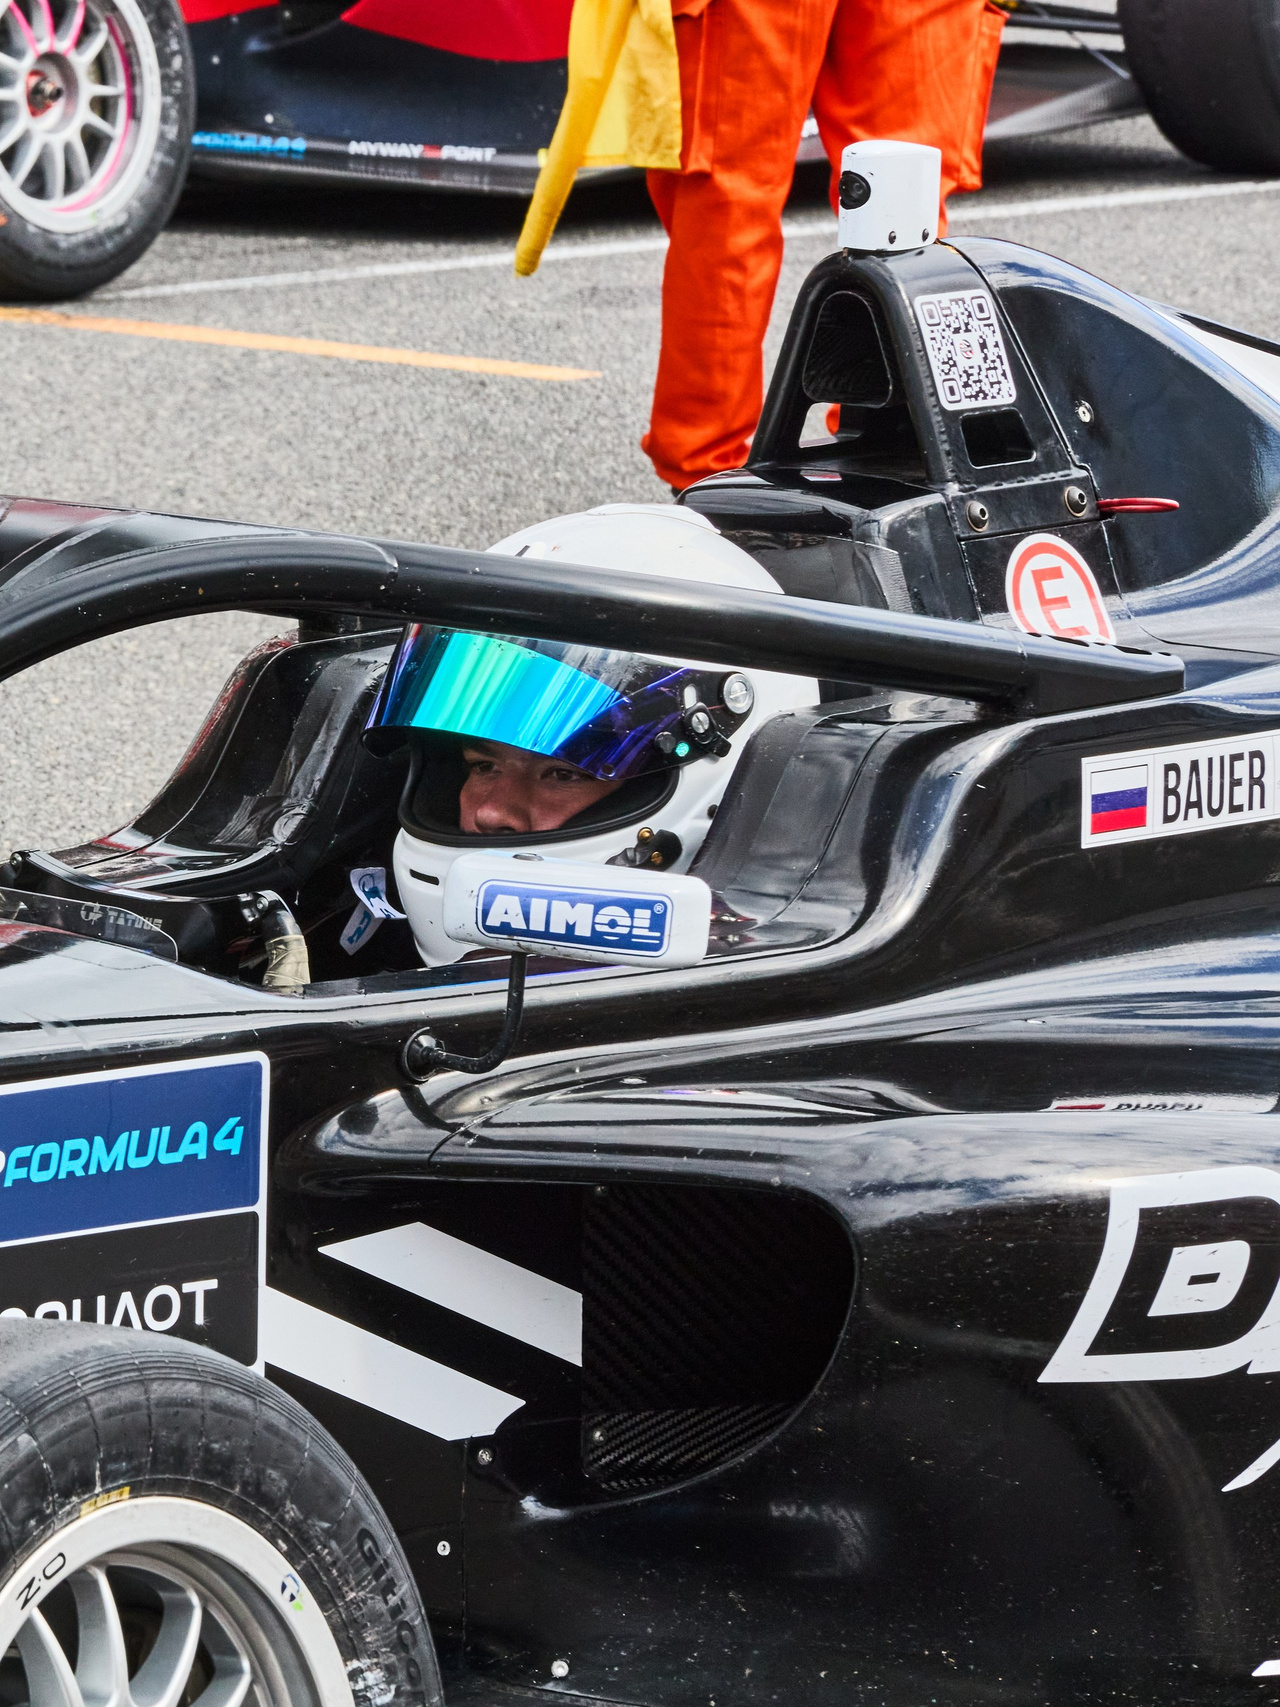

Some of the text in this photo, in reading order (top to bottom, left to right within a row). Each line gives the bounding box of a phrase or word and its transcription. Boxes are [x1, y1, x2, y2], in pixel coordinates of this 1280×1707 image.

[1030, 565, 1092, 638] E
[1162, 749, 1266, 825] BAUER
[485, 893, 662, 944] AIMOL
